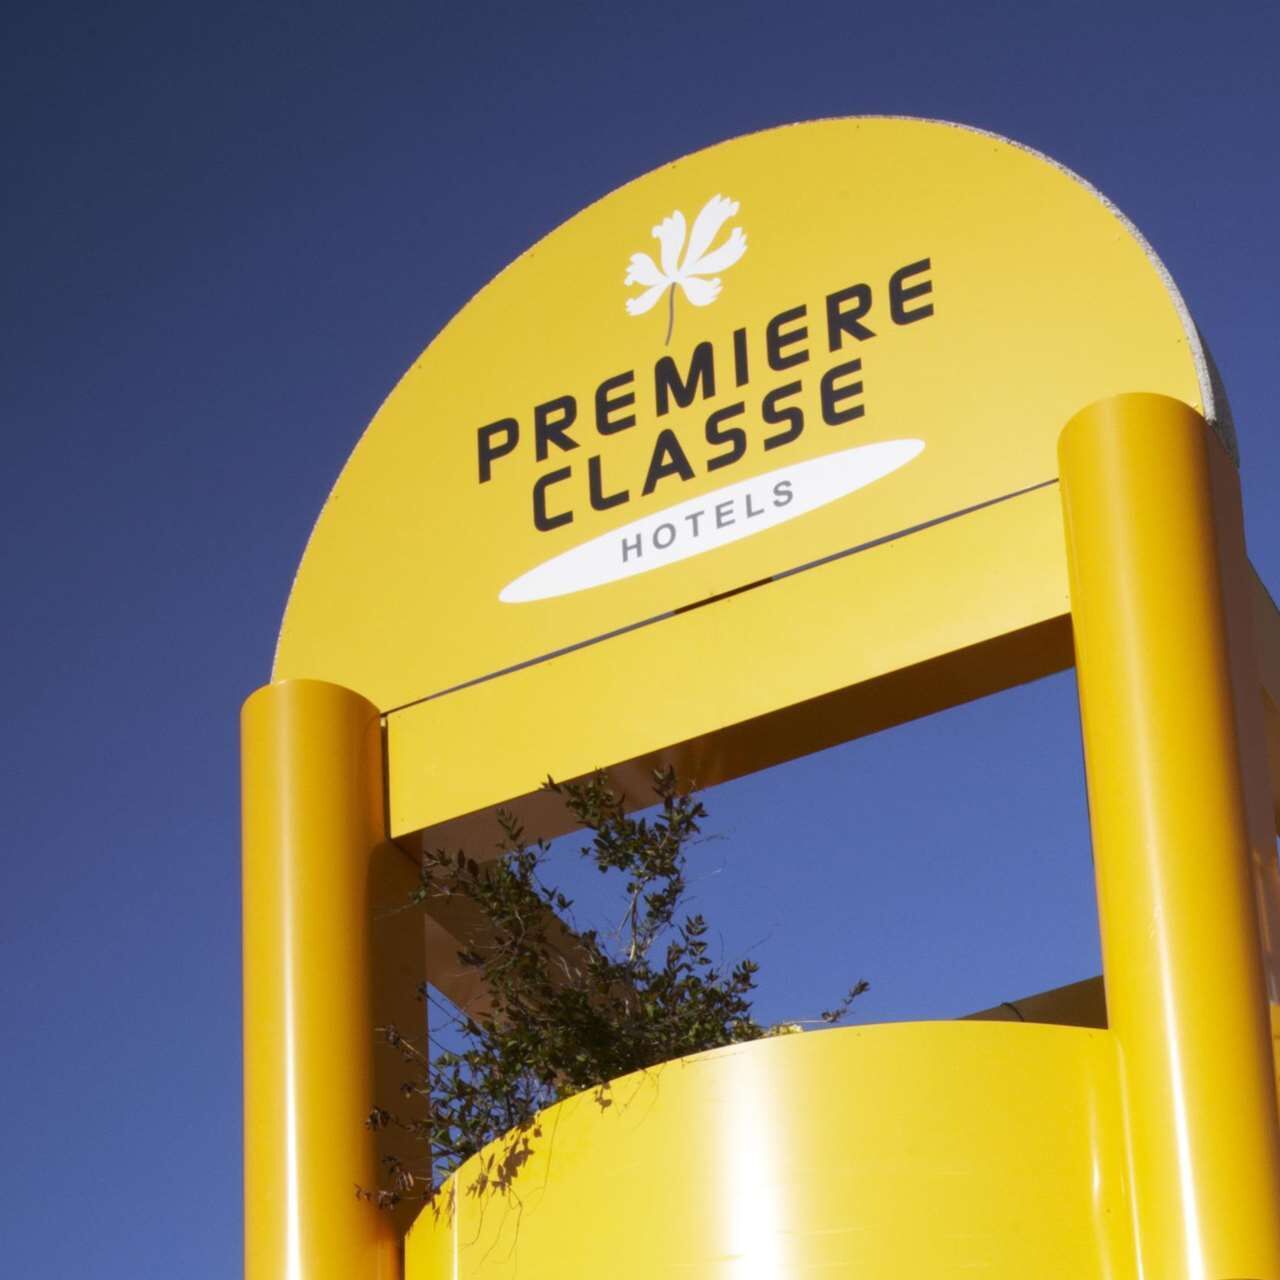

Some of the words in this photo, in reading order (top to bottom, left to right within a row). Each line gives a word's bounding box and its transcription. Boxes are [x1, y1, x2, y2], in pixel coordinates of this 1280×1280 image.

[477, 257, 935, 484] PREMIERE
[532, 358, 866, 532] CLASSE
[621, 480, 794, 563] HOTELS
